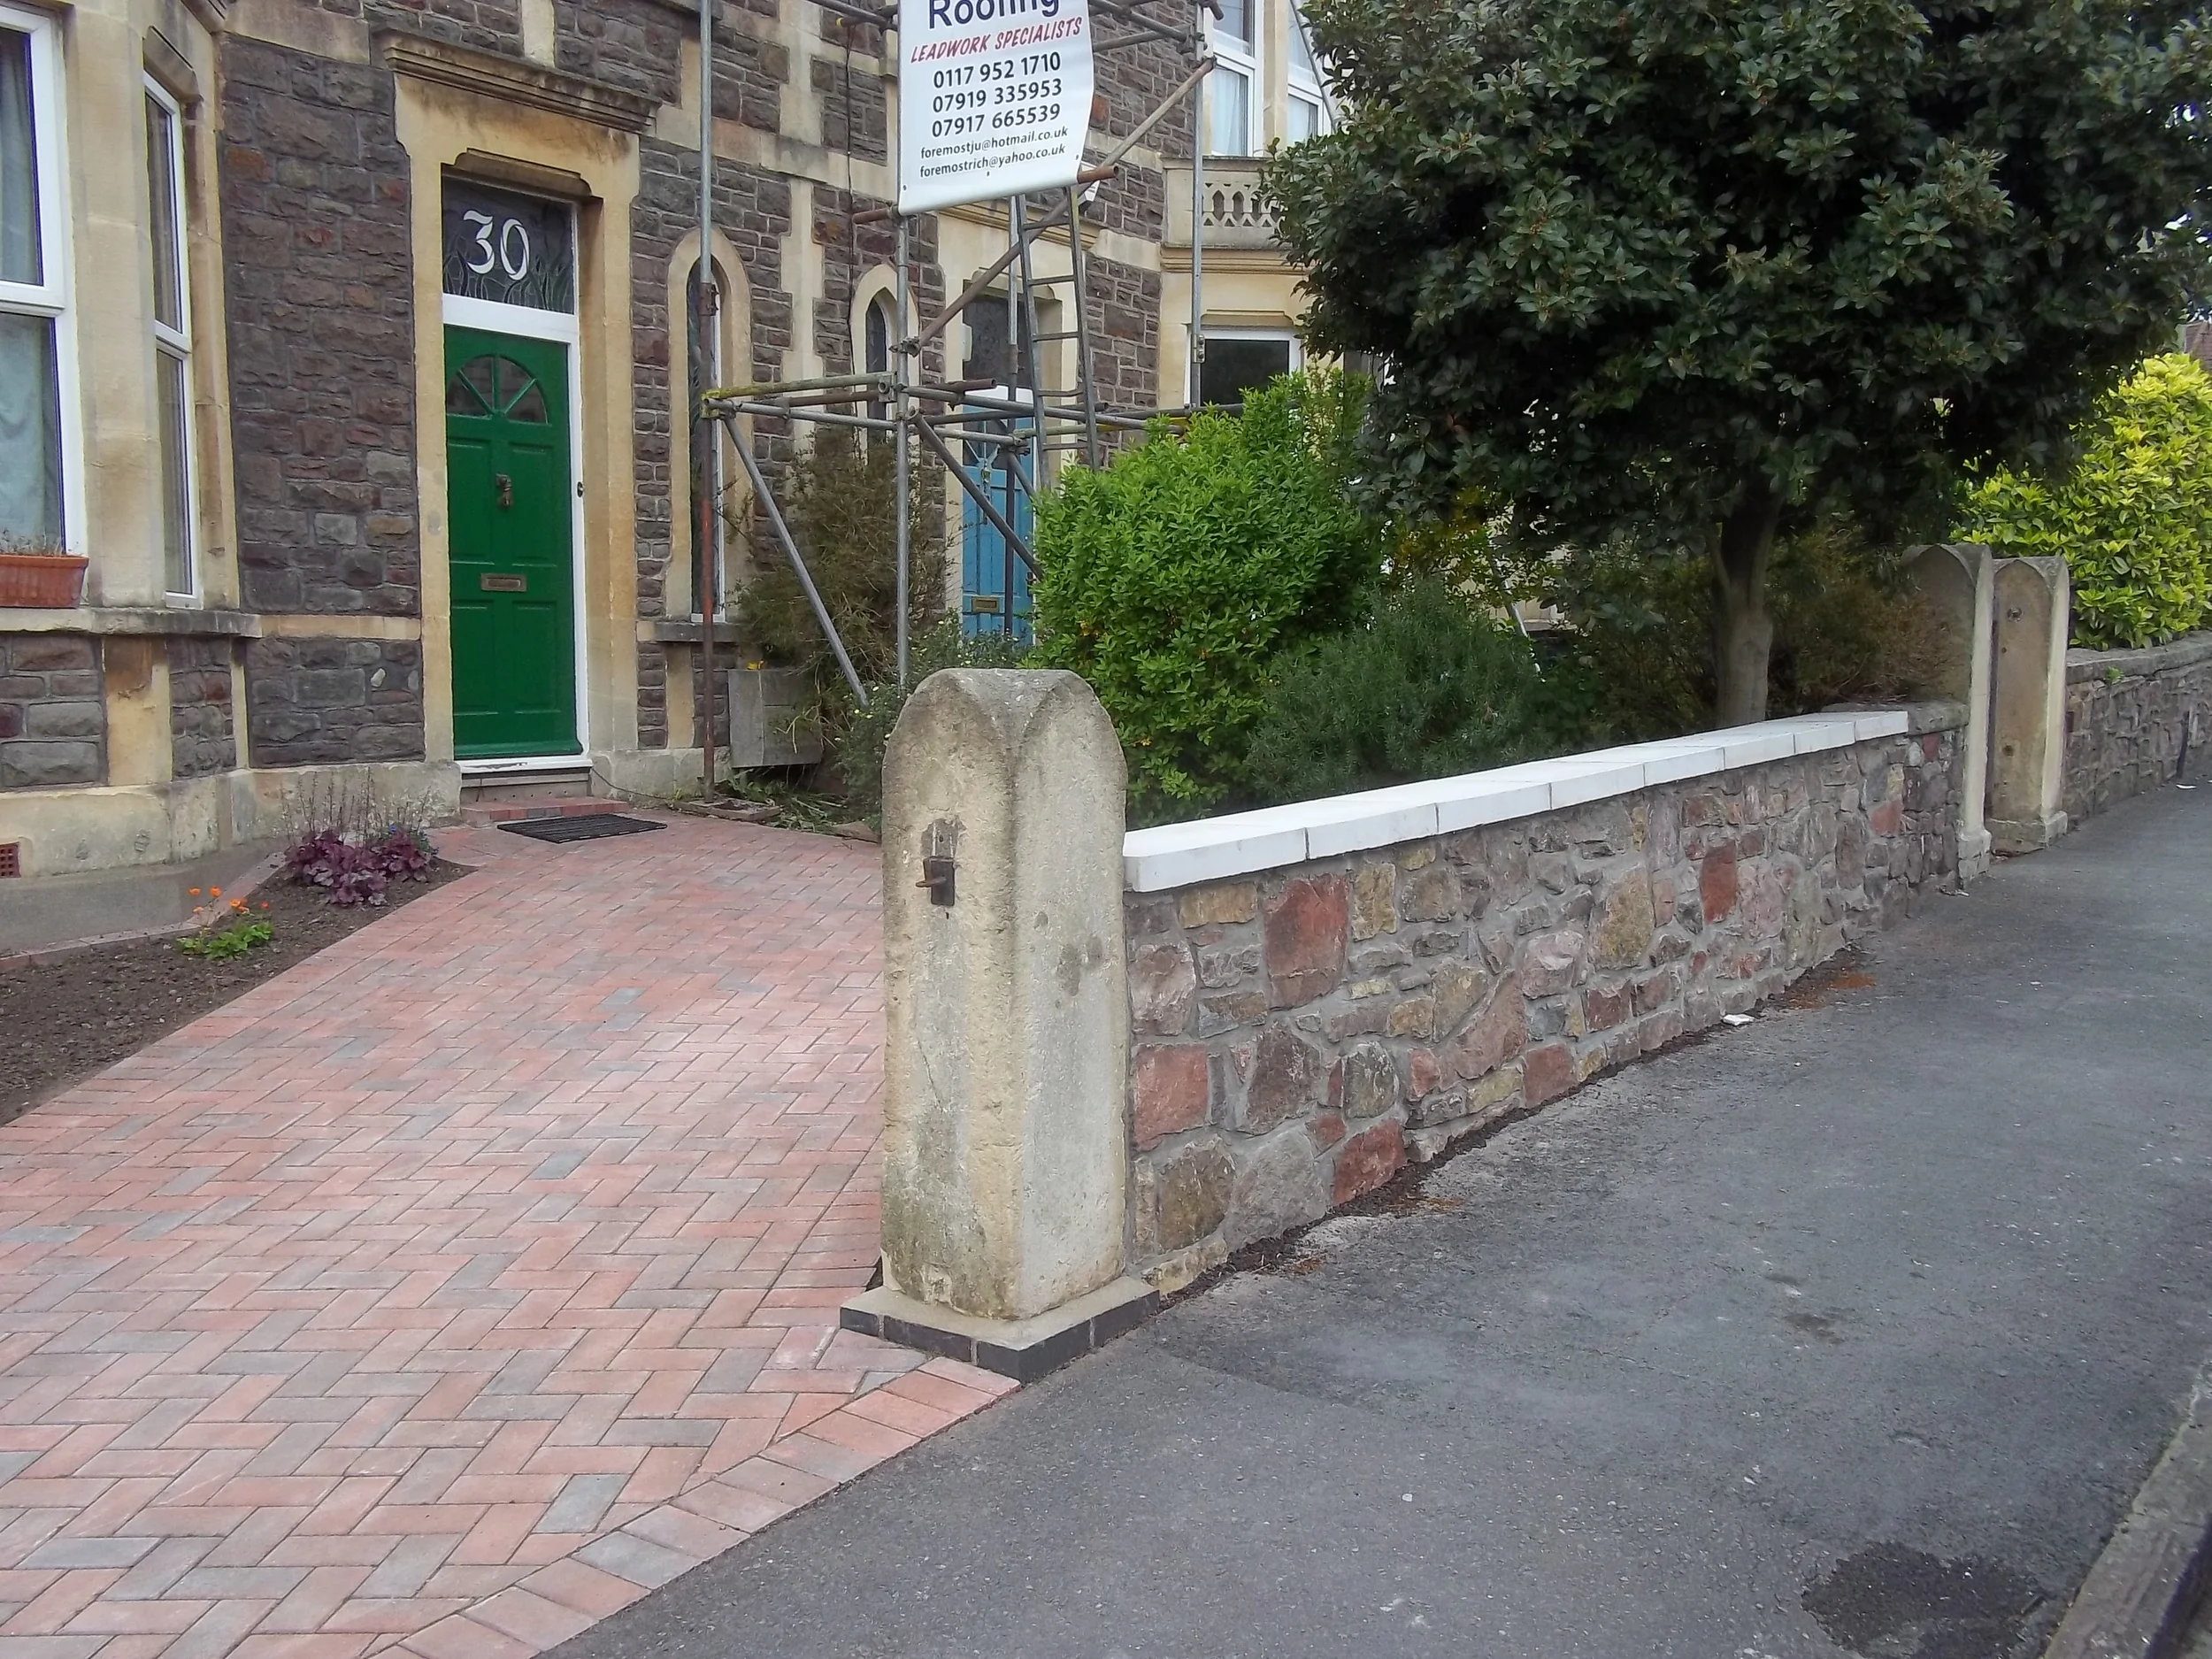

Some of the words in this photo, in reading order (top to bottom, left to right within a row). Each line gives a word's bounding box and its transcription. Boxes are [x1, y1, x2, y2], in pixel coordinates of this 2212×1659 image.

[910, 34, 991, 64] LEADWORK
[995, 17, 1082, 50] SPECIALISTS
[933, 66, 974, 88] 0117
[979, 59, 1015, 82] 952
[1020, 51, 1061, 76] 1710
[933, 89, 987, 113] 07919
[994, 78, 1062, 104] 335953
[932, 114, 985, 138] 07917
[992, 103, 1061, 129] 665539
[921, 126, 1068, 159] foremostju@hotmail.co.uk
[920, 143, 1065, 178] foremostrich@yahoo.co.uk
[463, 210, 530, 281] 30
